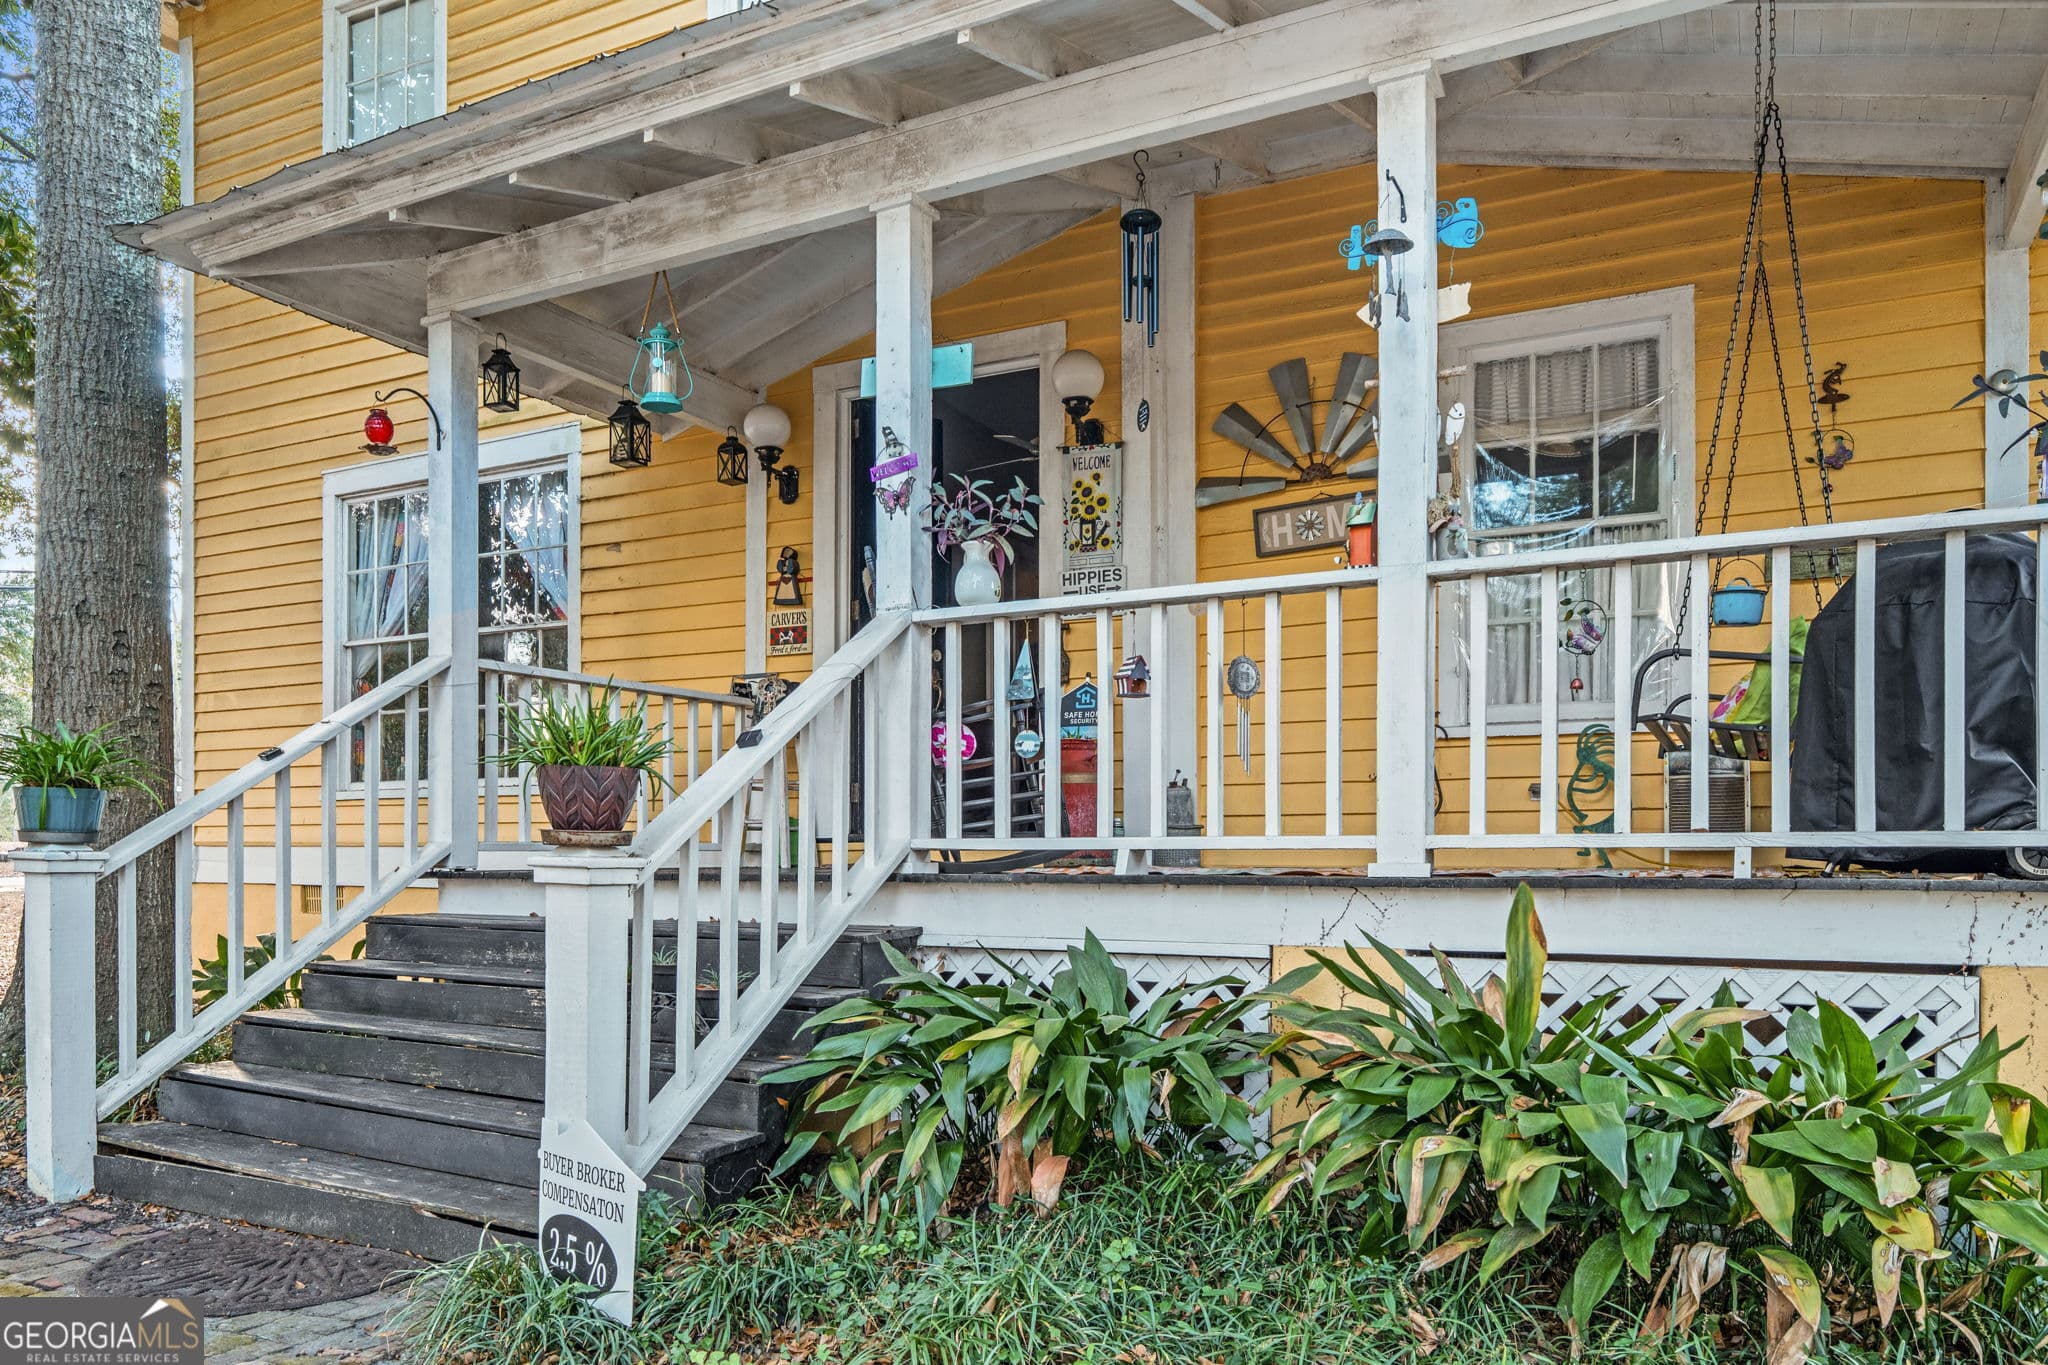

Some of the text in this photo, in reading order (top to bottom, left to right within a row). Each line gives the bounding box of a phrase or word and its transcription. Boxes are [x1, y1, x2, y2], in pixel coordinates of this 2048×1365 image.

[1072, 454, 1111, 471] WELCOME
[1062, 568, 1123, 587] HIPPIES
[1079, 584, 1106, 596] USE
[1064, 711, 1083, 719] SAFE
[543, 1151, 626, 1193] BUYER BROKER
[542, 1179, 625, 1224] COMPENSATON
